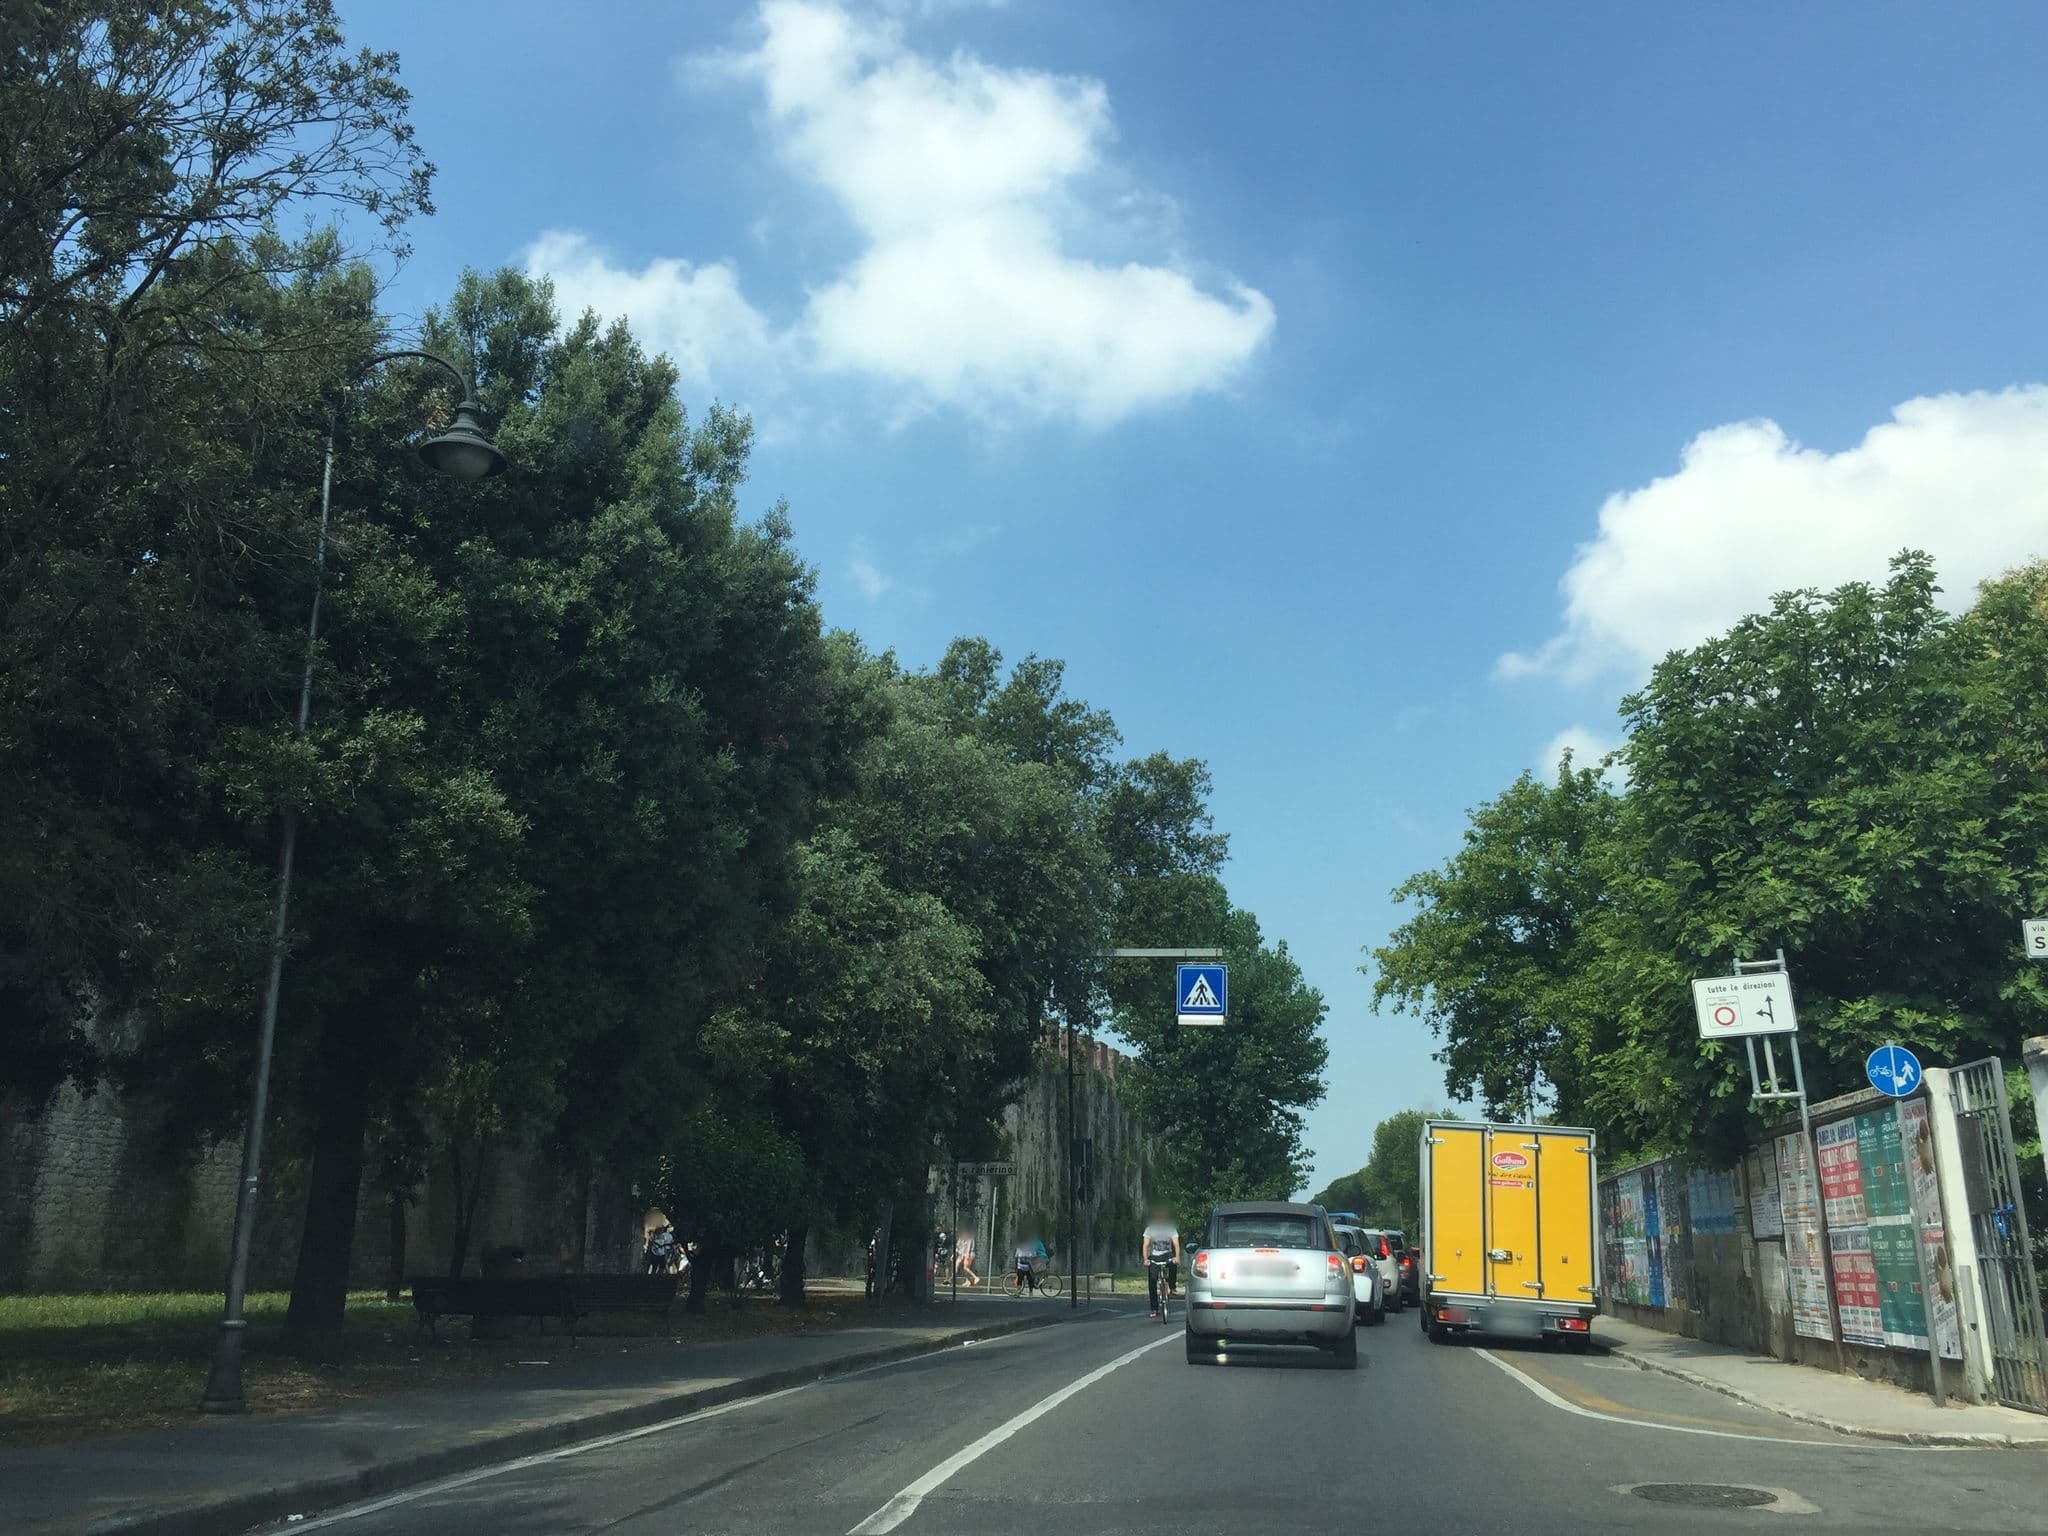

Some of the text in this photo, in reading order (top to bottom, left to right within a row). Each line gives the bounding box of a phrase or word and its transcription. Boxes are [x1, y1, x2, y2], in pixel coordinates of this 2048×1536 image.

[2031, 924, 2046, 932] via
[1707, 981, 1775, 993] tutte le direzioni
[1494, 1155, 1525, 1165] Galbani
